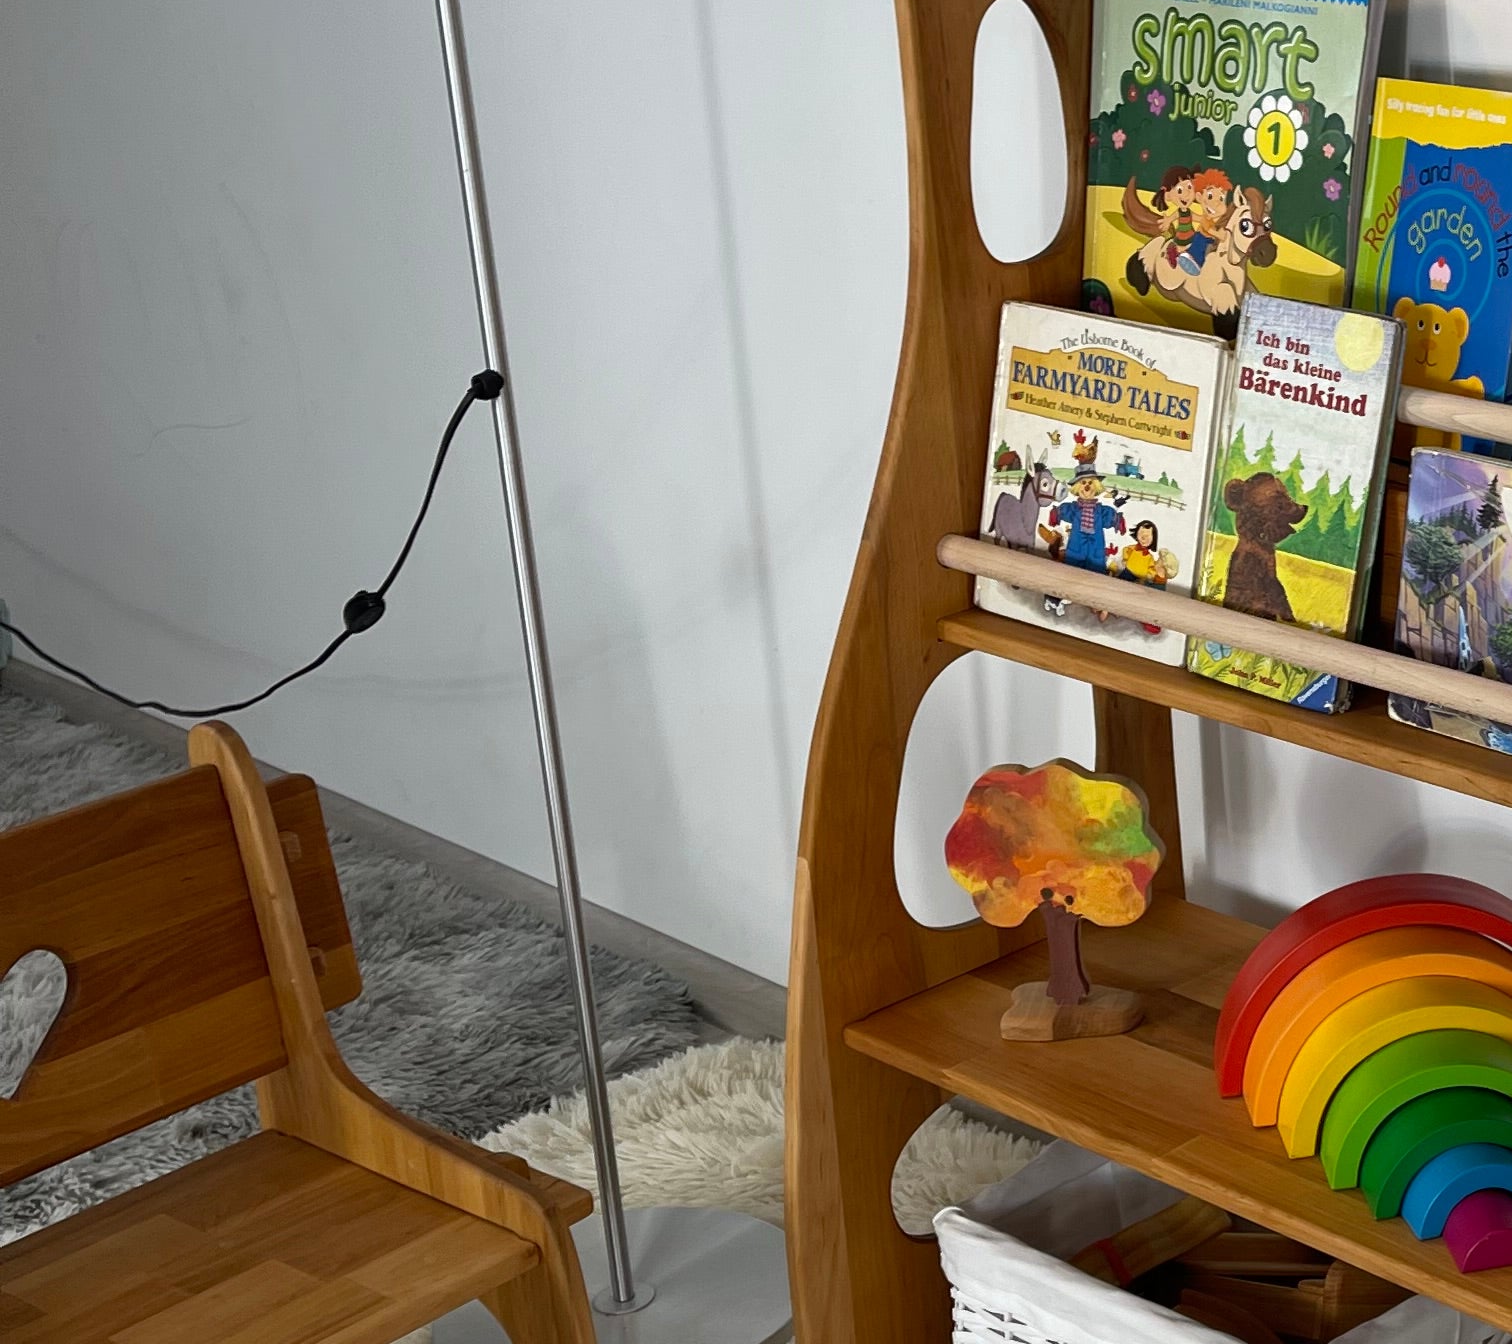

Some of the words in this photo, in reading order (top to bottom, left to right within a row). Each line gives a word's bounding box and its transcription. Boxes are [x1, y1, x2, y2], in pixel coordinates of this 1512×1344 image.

[1253, 0, 1318, 16] MALKOGIANNI
[1132, 7, 1319, 101] smart
[1169, 83, 1238, 125] junior
[1267, 121, 1281, 155] 1
[1363, 164, 1419, 254] Round
[1419, 157, 1453, 186] and
[1407, 206, 1483, 262] garden
[1060, 336, 1078, 350] The
[1080, 329, 1119, 348] Usborne
[1121, 338, 1145, 361] Book
[1145, 359, 1157, 371] of
[1256, 330, 1280, 348] Ich
[1285, 336, 1311, 355] bin
[1078, 352, 1128, 380] MORE
[1263, 353, 1289, 370] das
[1292, 359, 1342, 383] kleine
[1012, 361, 1123, 404] FARMYARD
[1127, 386, 1192, 421] TALES
[1239, 366, 1368, 417] Bärenkind
[1025, 393, 1057, 410] Heather
[1058, 402, 1084, 419] Amery
[1085, 407, 1092, 418] &
[1095, 409, 1127, 426] Stephen
[1128, 417, 1173, 438] Cartwright
